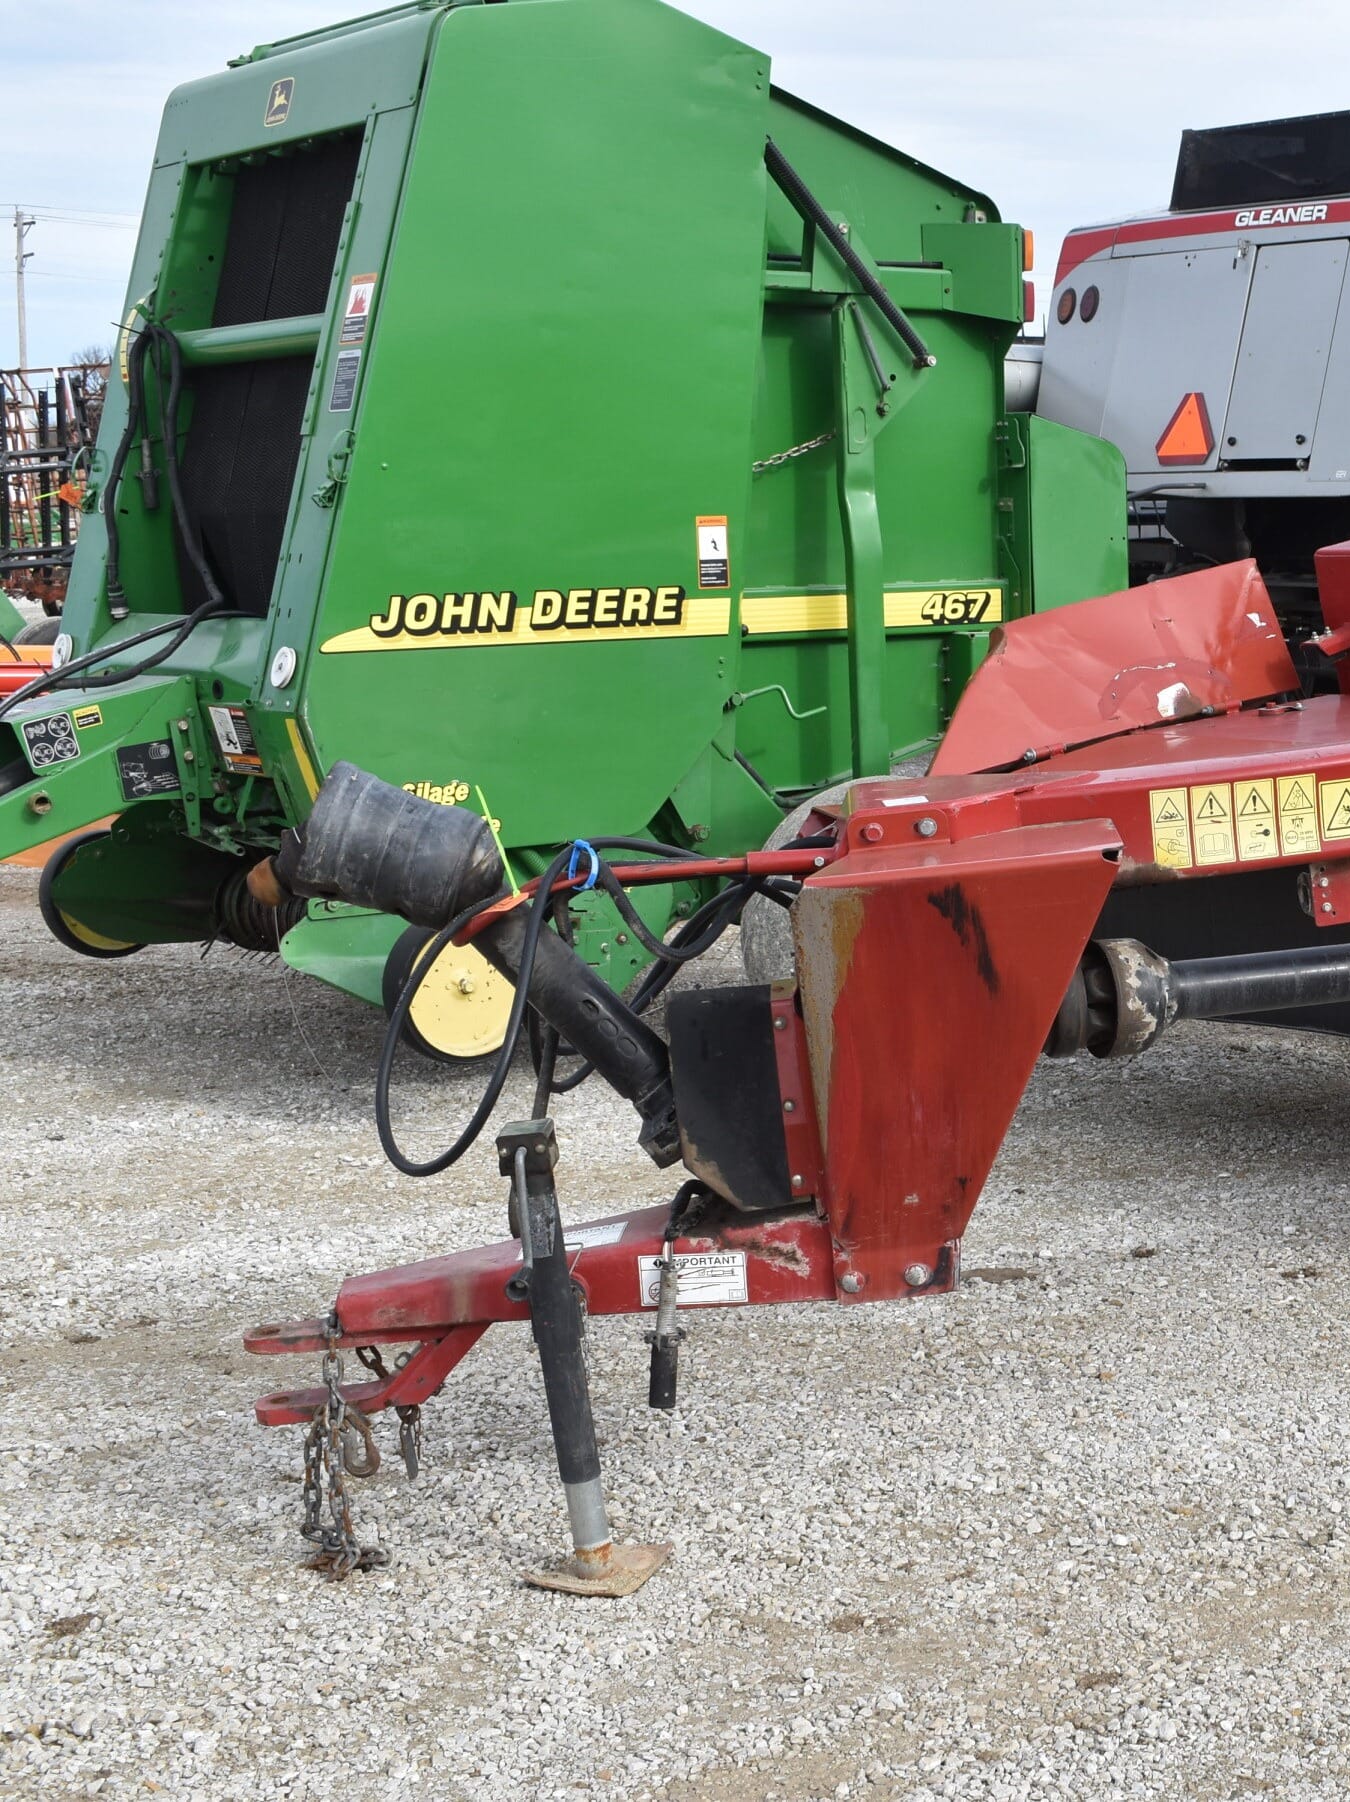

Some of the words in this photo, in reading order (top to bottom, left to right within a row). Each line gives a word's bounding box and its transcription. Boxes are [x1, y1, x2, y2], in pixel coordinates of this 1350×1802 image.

[1235, 205, 1328, 227] GLEANER
[370, 591, 518, 638] JOHN
[530, 585, 684, 631] DEERE
[921, 591, 991, 624] 467
[402, 780, 470, 806] Silage
[672, 1255, 737, 1267] MPORTANT
